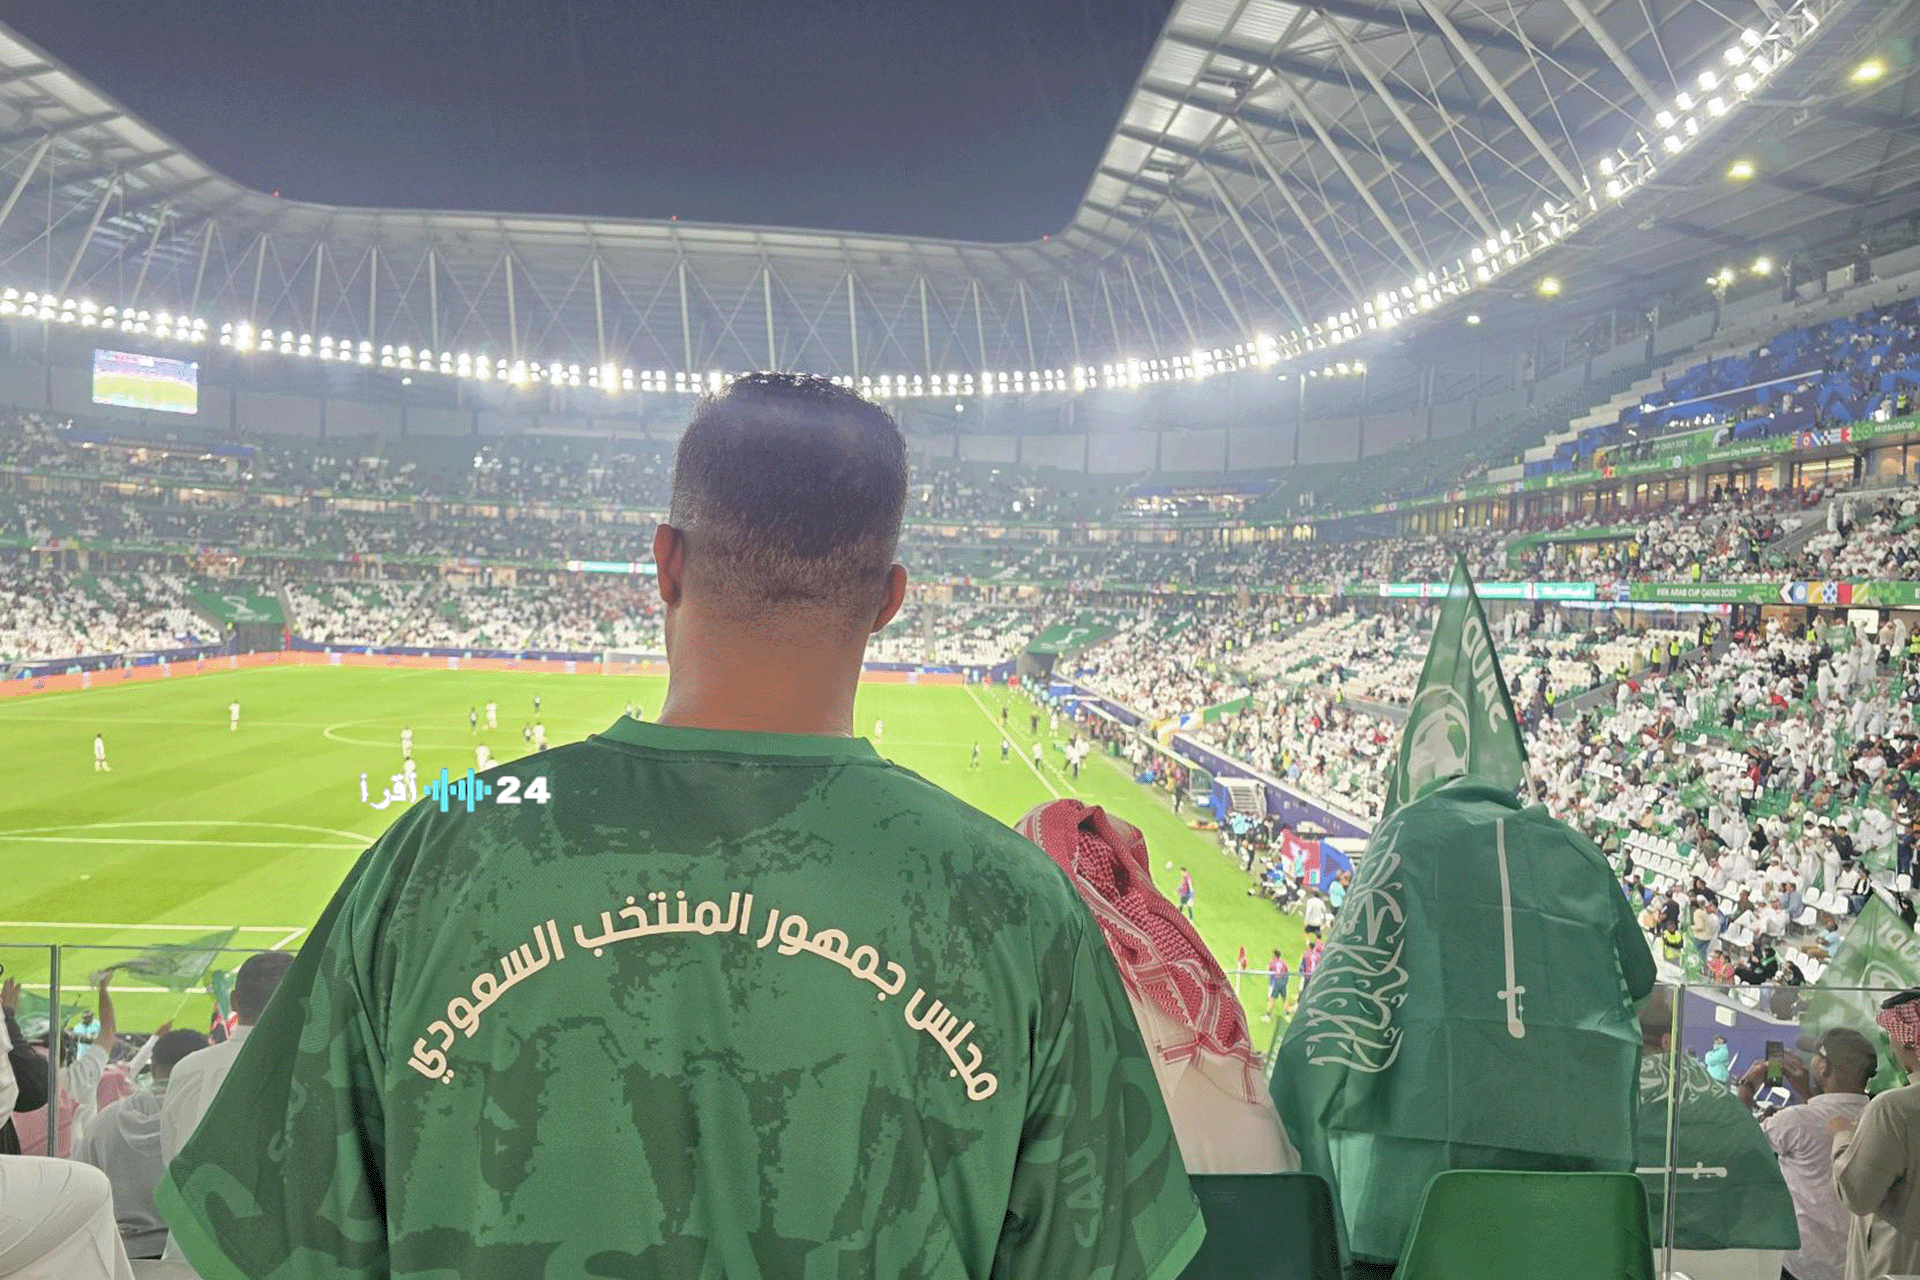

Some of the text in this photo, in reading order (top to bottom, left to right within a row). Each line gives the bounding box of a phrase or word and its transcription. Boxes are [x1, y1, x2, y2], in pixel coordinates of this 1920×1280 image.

[1687, 587, 1700, 597] CUP
[407, 890, 998, 1101] مجلس جمهور المنتخب السعودي
